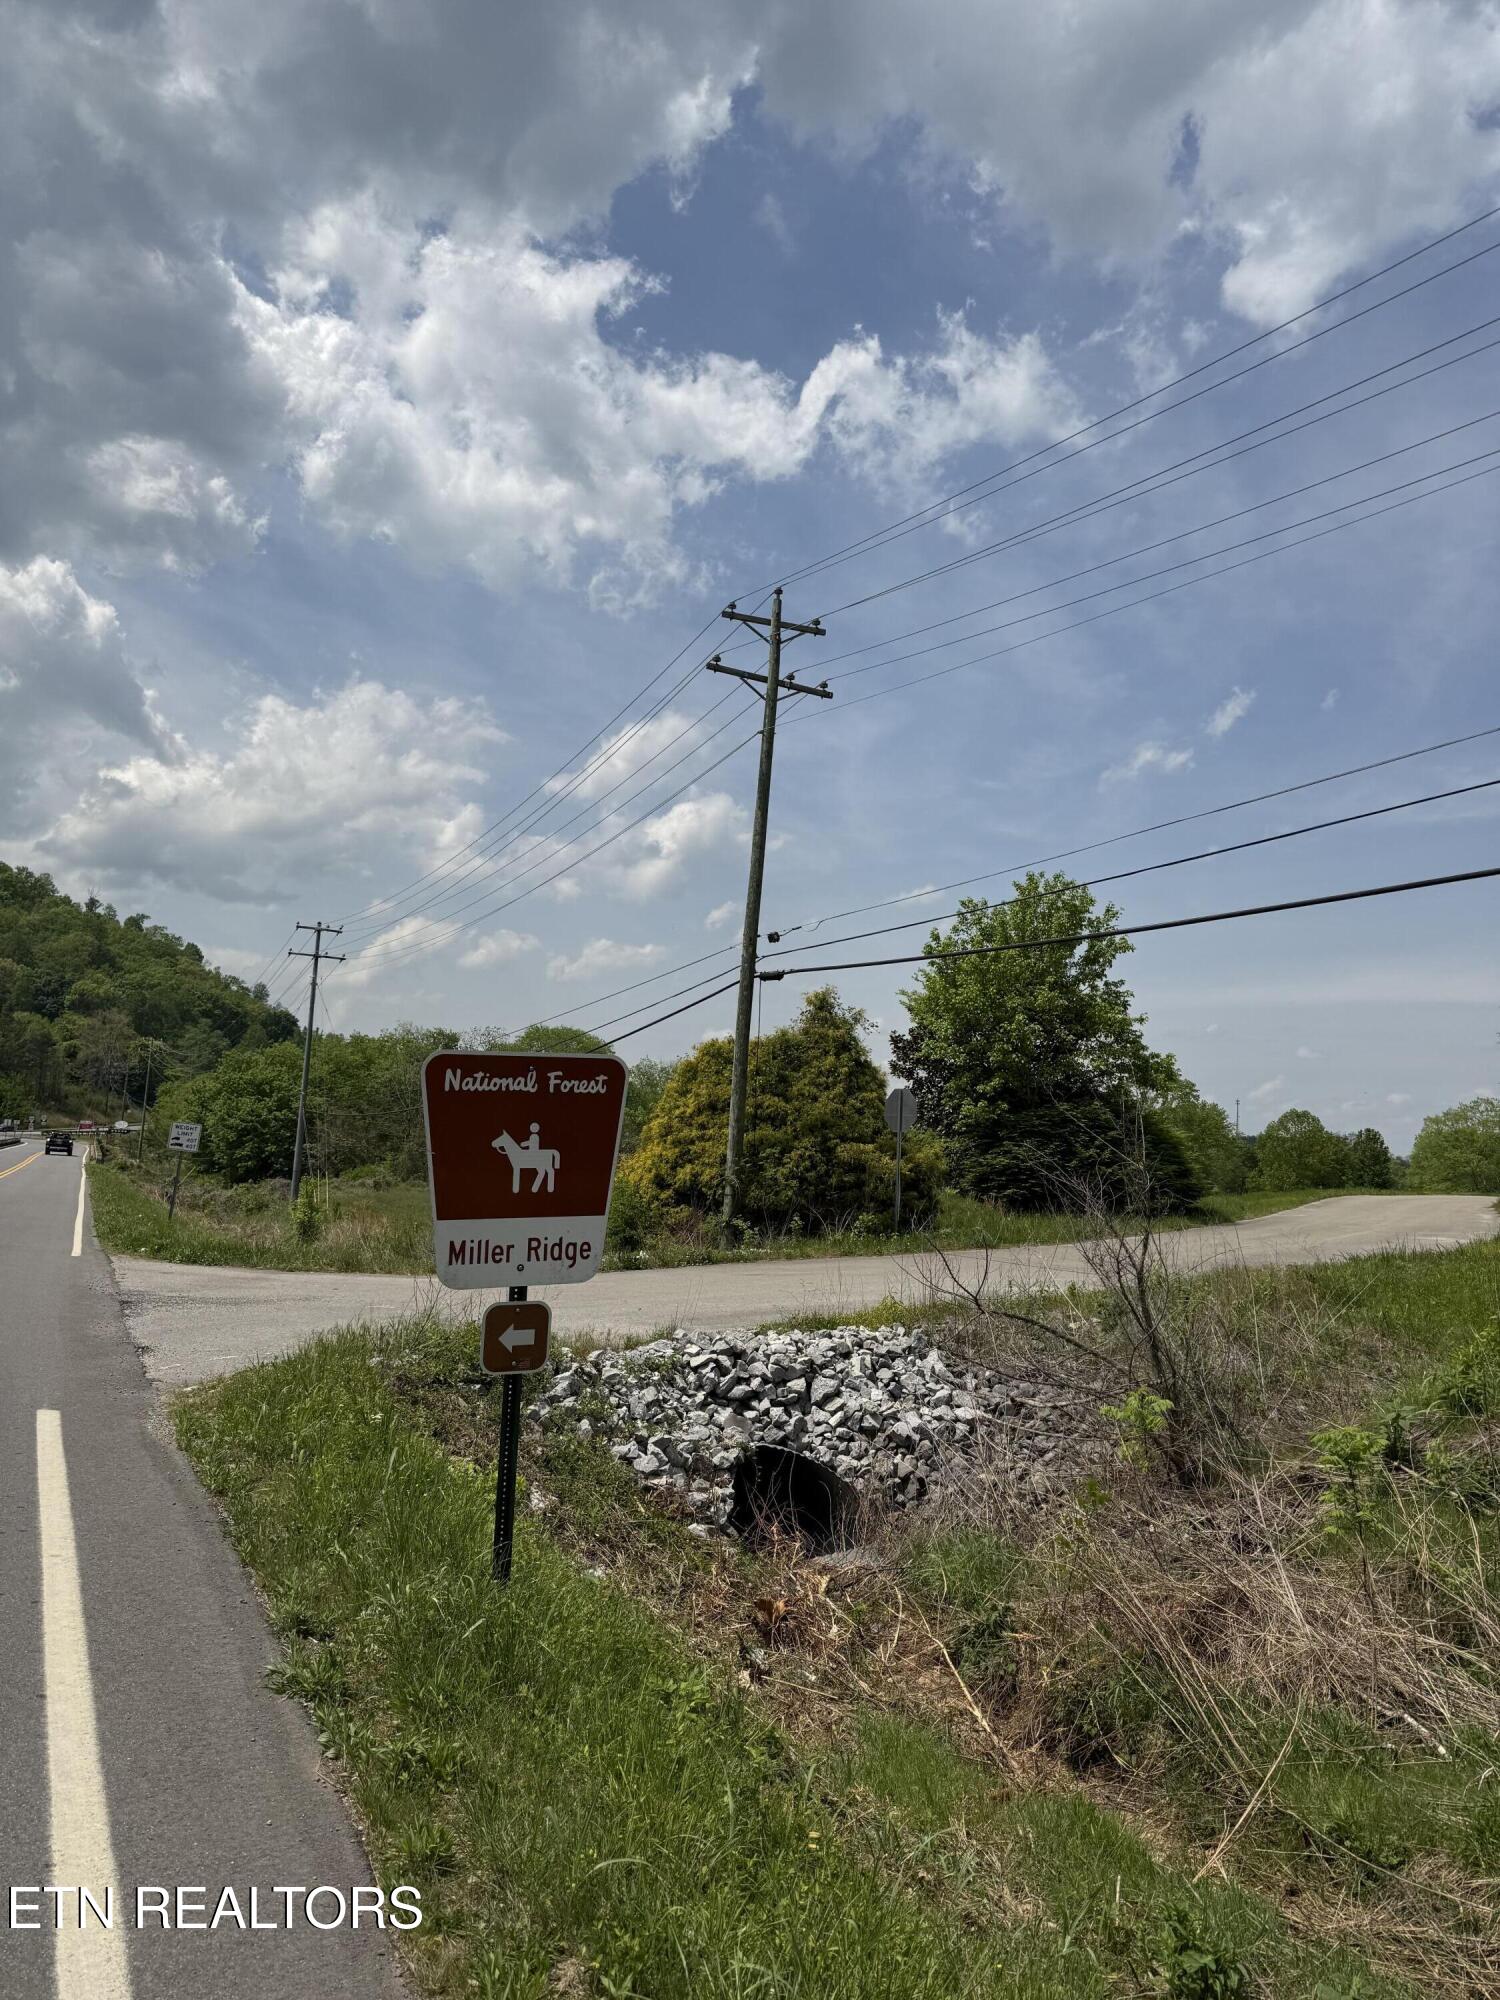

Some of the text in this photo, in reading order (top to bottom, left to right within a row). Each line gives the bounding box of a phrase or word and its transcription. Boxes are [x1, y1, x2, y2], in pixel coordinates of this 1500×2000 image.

[444, 1068, 609, 1094] National Forest
[175, 1124, 198, 1132] WEIGHT
[448, 1236, 592, 1269] Miller Ridge
